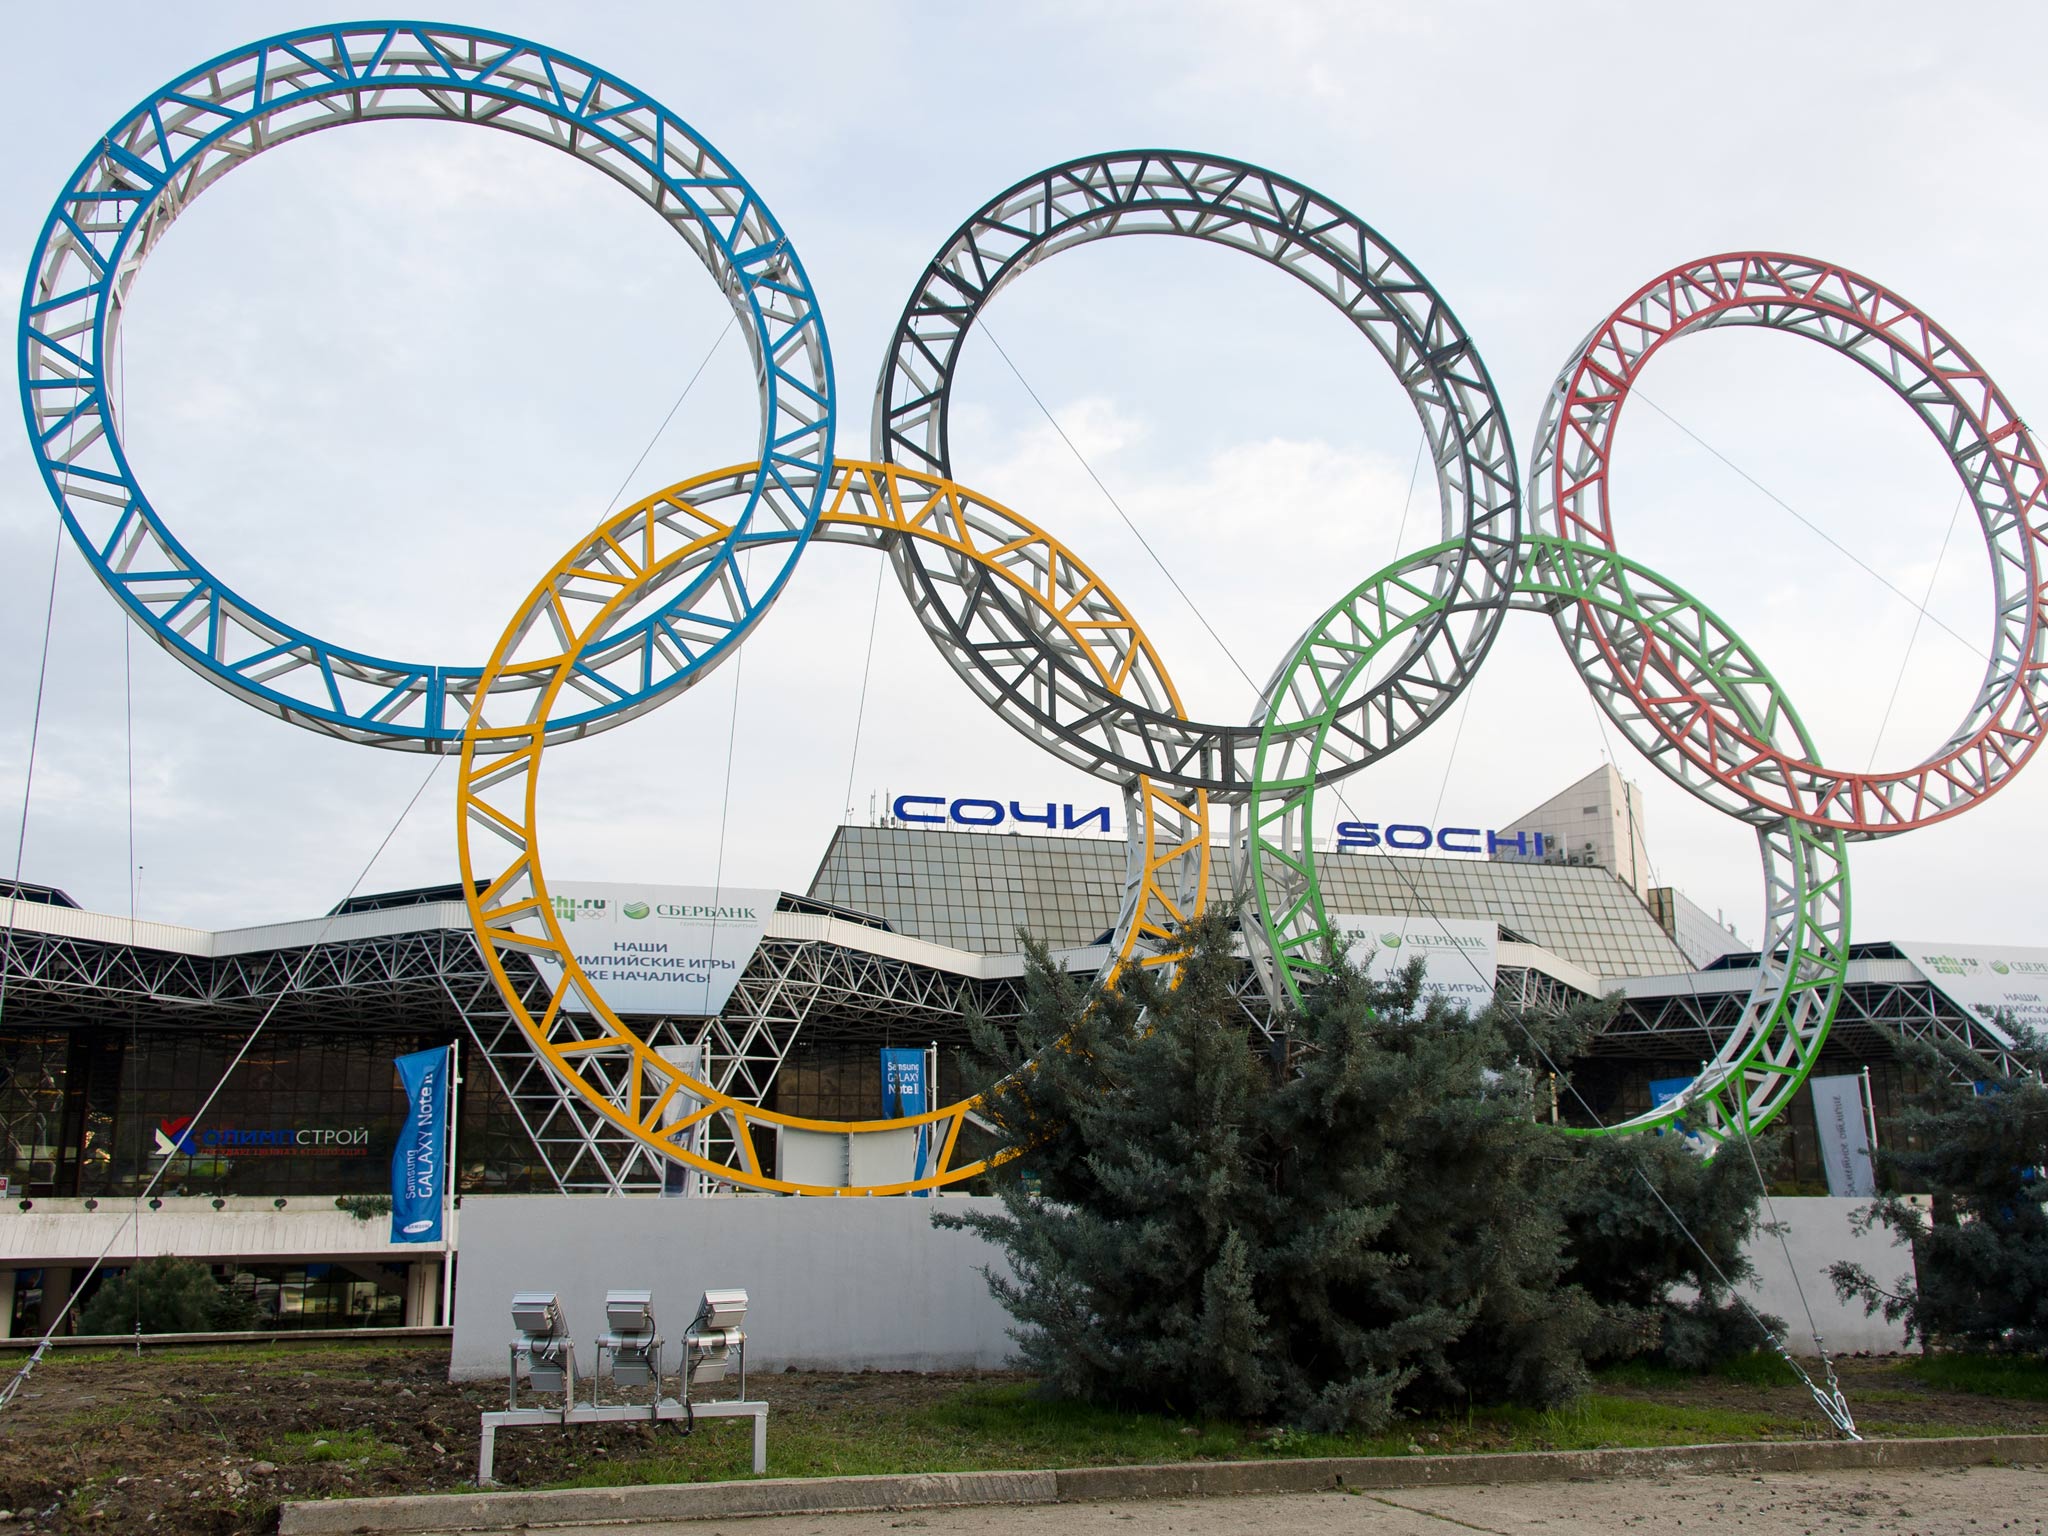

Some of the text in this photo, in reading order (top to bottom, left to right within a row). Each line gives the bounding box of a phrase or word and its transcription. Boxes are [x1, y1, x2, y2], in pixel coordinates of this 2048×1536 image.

[893, 795, 1110, 832] СОЧИ
[1337, 822, 1543, 856] SOCHI
[656, 904, 757, 918] СБЕРБАНК
[614, 942, 668, 952] НАШИ
[1405, 934, 1487, 947] СБЕРБАНК
[544, 955, 736, 969] ОИМПИЙСКИЕ ИГРЫ
[583, 970, 711, 983] ЖЕ НАЧАЛИСЬ!
[1448, 983, 1487, 993] ИГРЫ
[418, 1087, 433, 1127] Note
[203, 1127, 368, 1145] ОЛИМПСТРОЙ
[418, 1131, 433, 1198] GALAXY
[406, 1150, 416, 1199] Samsung
